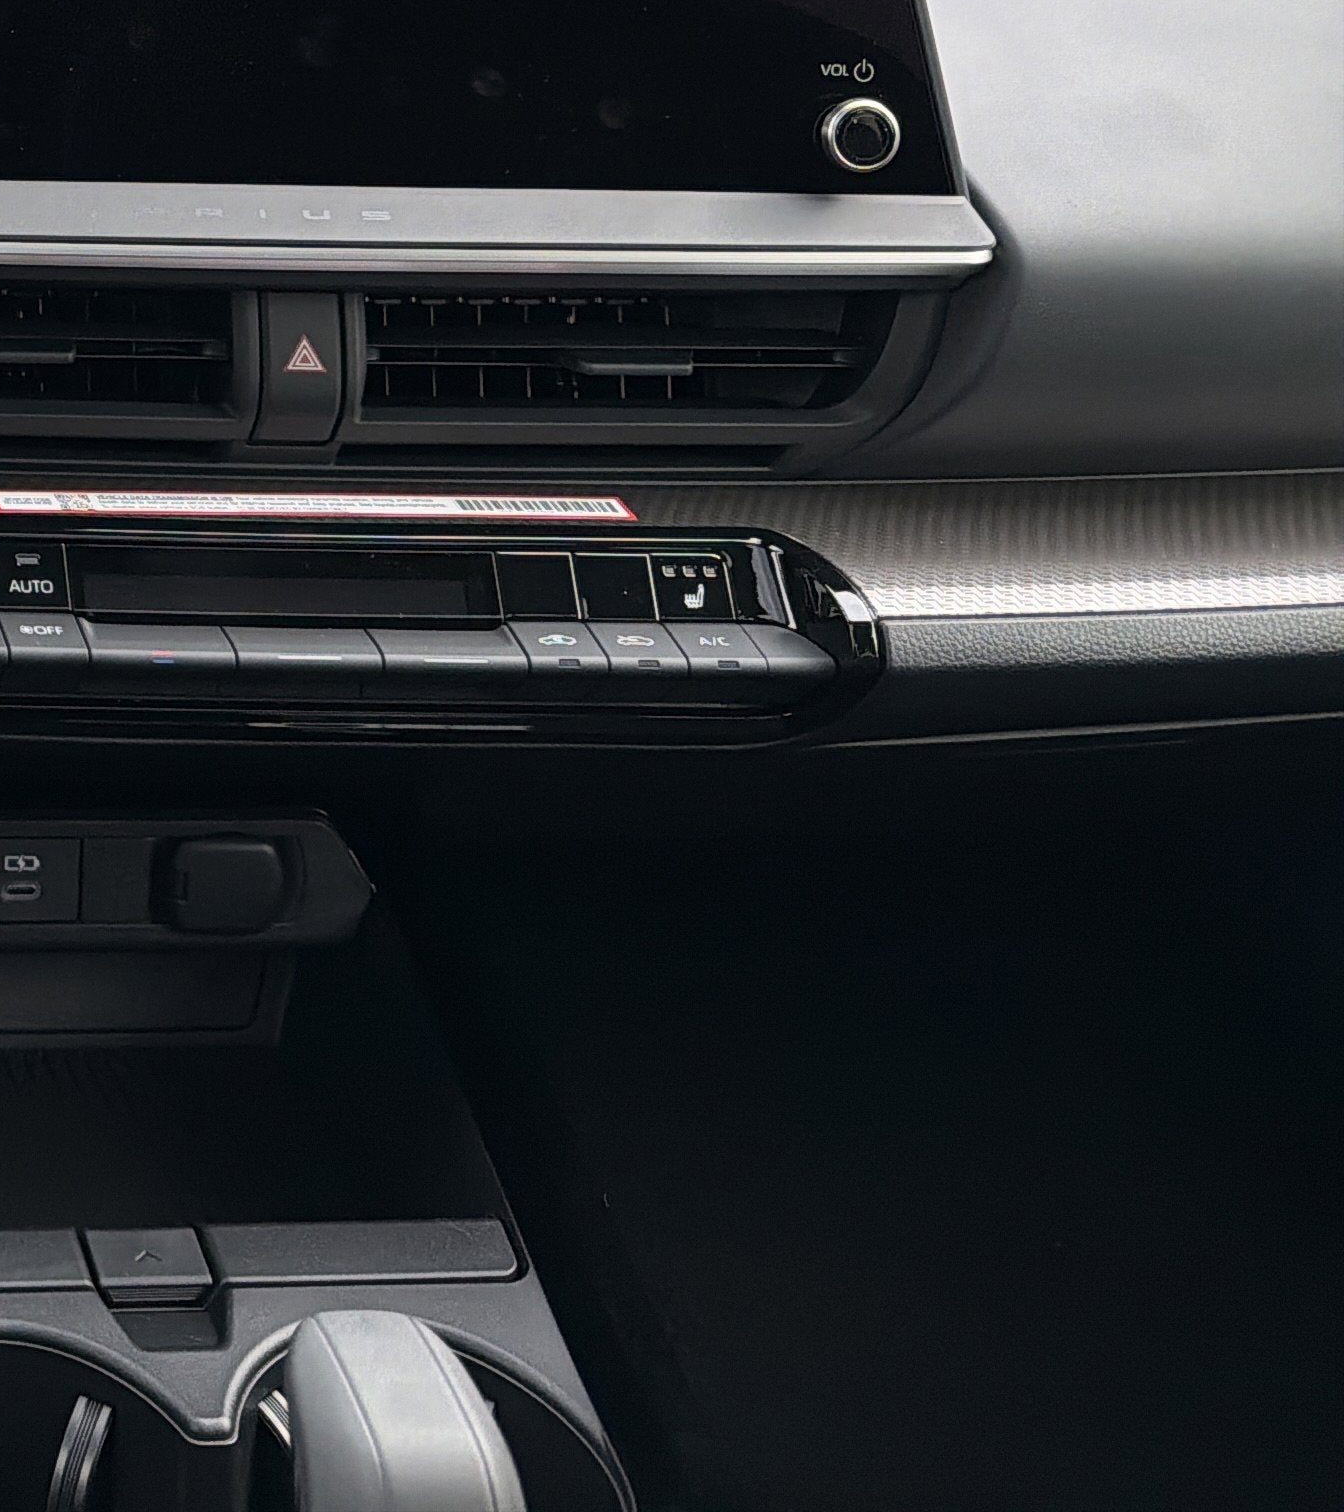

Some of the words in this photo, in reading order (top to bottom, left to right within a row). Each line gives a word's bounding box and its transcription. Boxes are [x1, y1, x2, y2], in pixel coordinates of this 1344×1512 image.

[820, 63, 849, 77] VOL
[8, 579, 55, 595] AUTO
[32, 625, 64, 636] OFF
[699, 635, 731, 647] A/C
